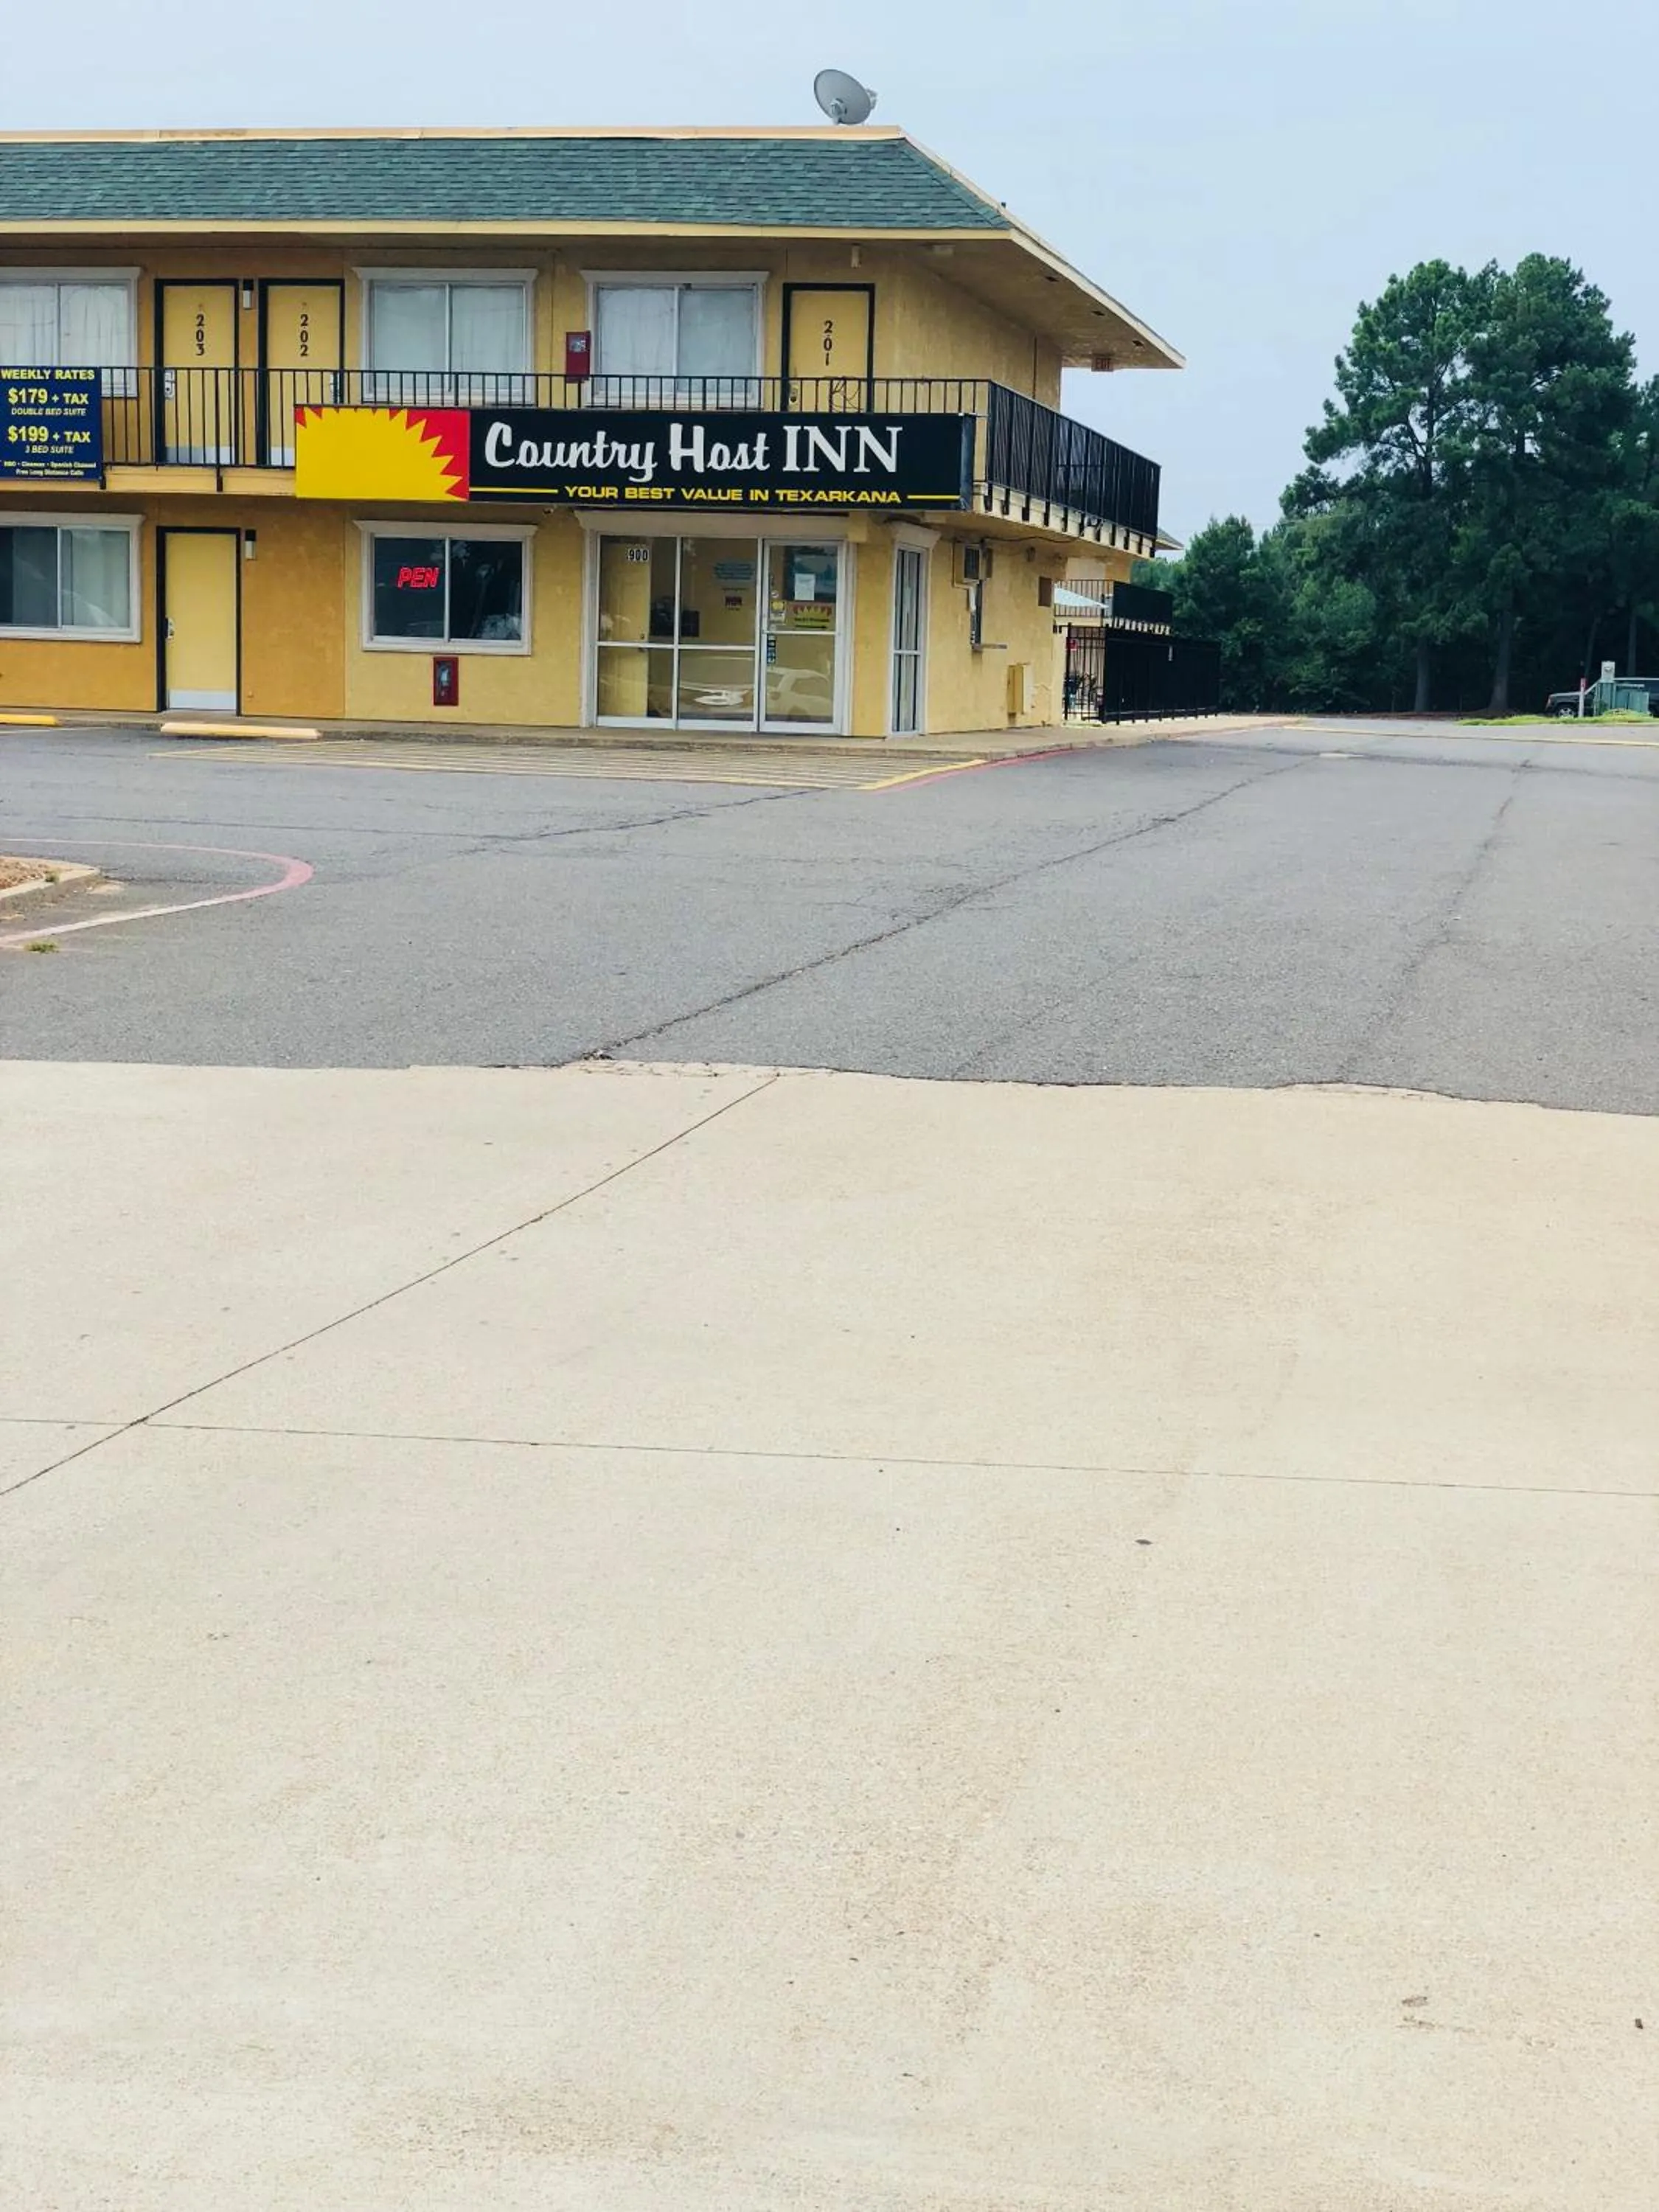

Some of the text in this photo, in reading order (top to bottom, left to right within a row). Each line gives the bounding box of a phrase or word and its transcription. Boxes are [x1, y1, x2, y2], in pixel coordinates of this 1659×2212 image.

[196, 314, 204, 355] 203
[300, 314, 308, 356] 202
[824, 319, 833, 366] 201
[1, 369, 95, 380] WEEKLY RATES
[8, 388, 48, 405] $179
[63, 394, 89, 404] TAX
[8, 425, 49, 442] $199
[63, 431, 91, 442] TAX
[32, 445, 49, 453] BED
[50, 445, 74, 454] SUITE
[484, 421, 903, 483] Country Host INN
[564, 486, 902, 504] YOUR BEST VALUE IN TEXARKANA
[628, 549, 649, 561] 900
[397, 566, 441, 589] PEN
